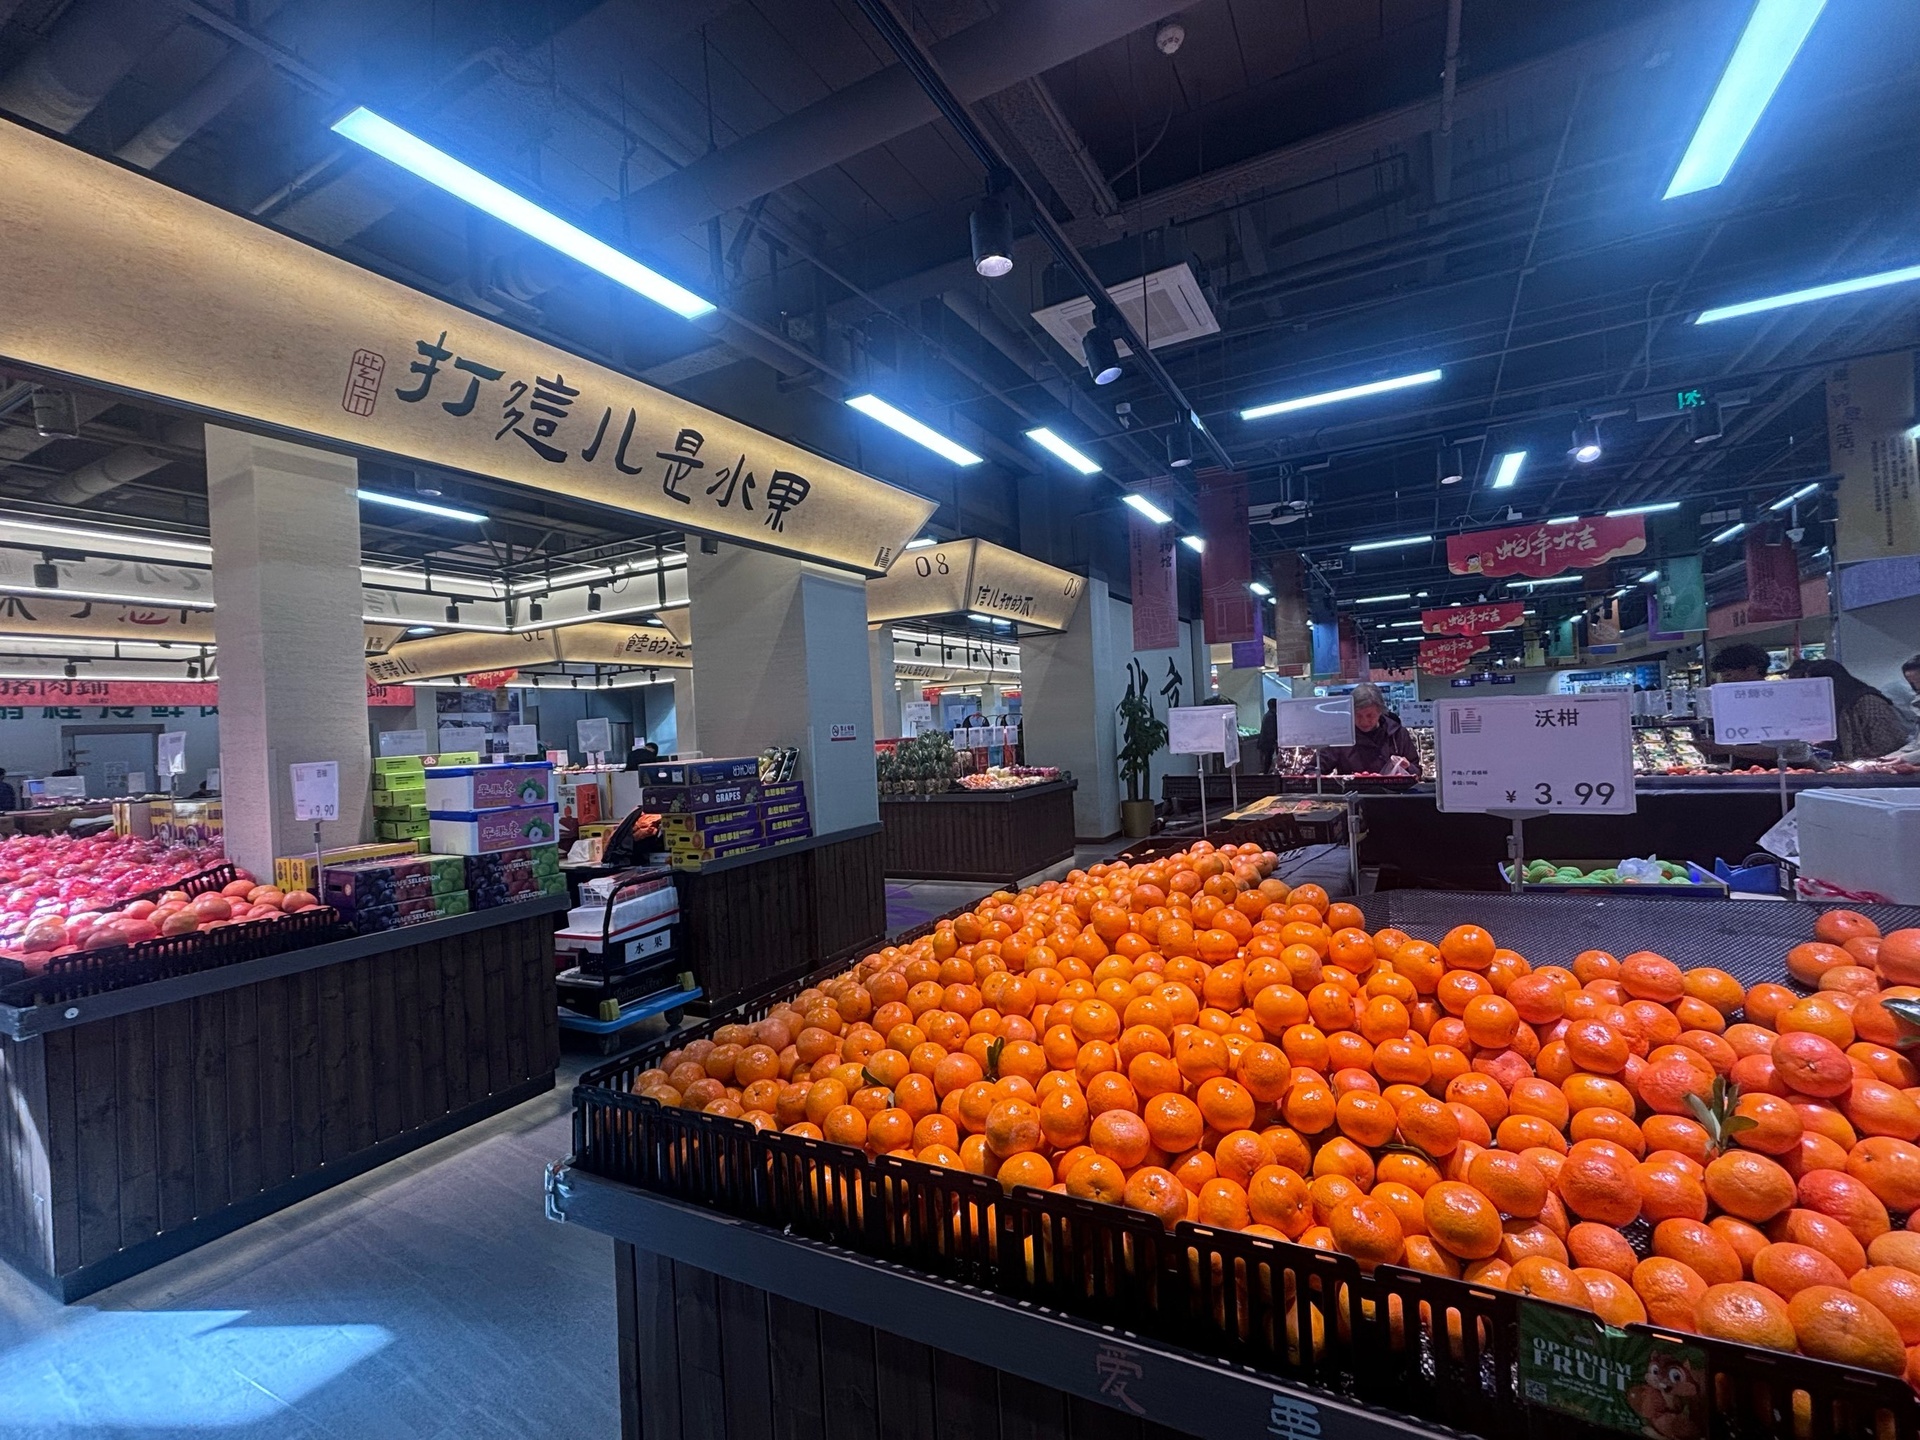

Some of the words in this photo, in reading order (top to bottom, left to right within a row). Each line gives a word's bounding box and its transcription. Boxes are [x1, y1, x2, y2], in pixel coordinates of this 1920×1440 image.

[1495, 524, 1598, 566] 蛇年大吉
[915, 553, 949, 578] 08
[1063, 577, 1081, 599] 08
[1448, 608, 1501, 630] 蛇年大吉
[1534, 708, 1579, 727] 沃柑
[715, 791, 741, 803] GRAPES
[1505, 790, 1517, 803] ¥
[1534, 782, 1615, 806] 3.99
[315, 804, 334, 816] 9.90
[407, 874, 441, 885] SELECTION
[411, 908, 446, 920] SELECTION
[635, 935, 663, 954] 水果
[1533, 1337, 1631, 1376] OPTIMUM
[1533, 1348, 1632, 1392] FRUIT
